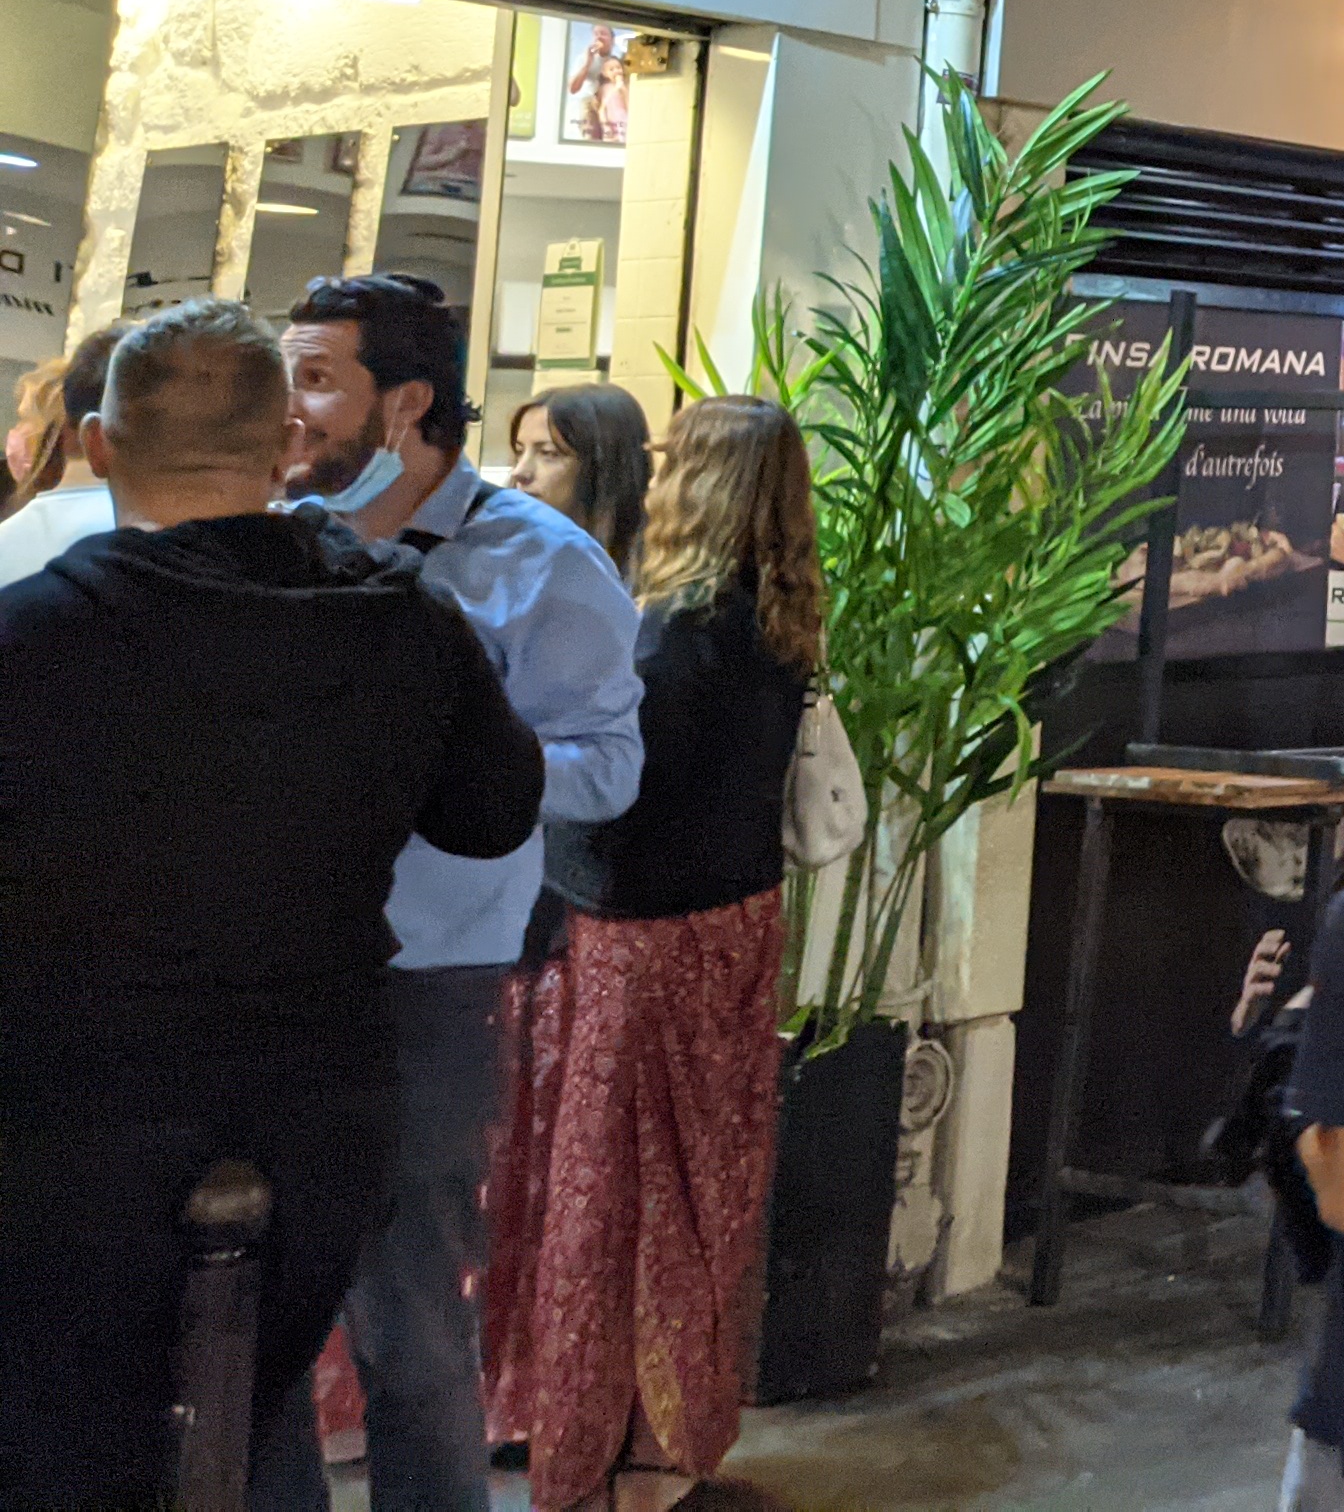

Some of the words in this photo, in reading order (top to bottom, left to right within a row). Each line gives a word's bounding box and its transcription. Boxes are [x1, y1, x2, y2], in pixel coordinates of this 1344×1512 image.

[1064, 333, 1162, 368] INS
[1188, 345, 1326, 377] ROMANA
[1185, 443, 1284, 488] d'autrefois
